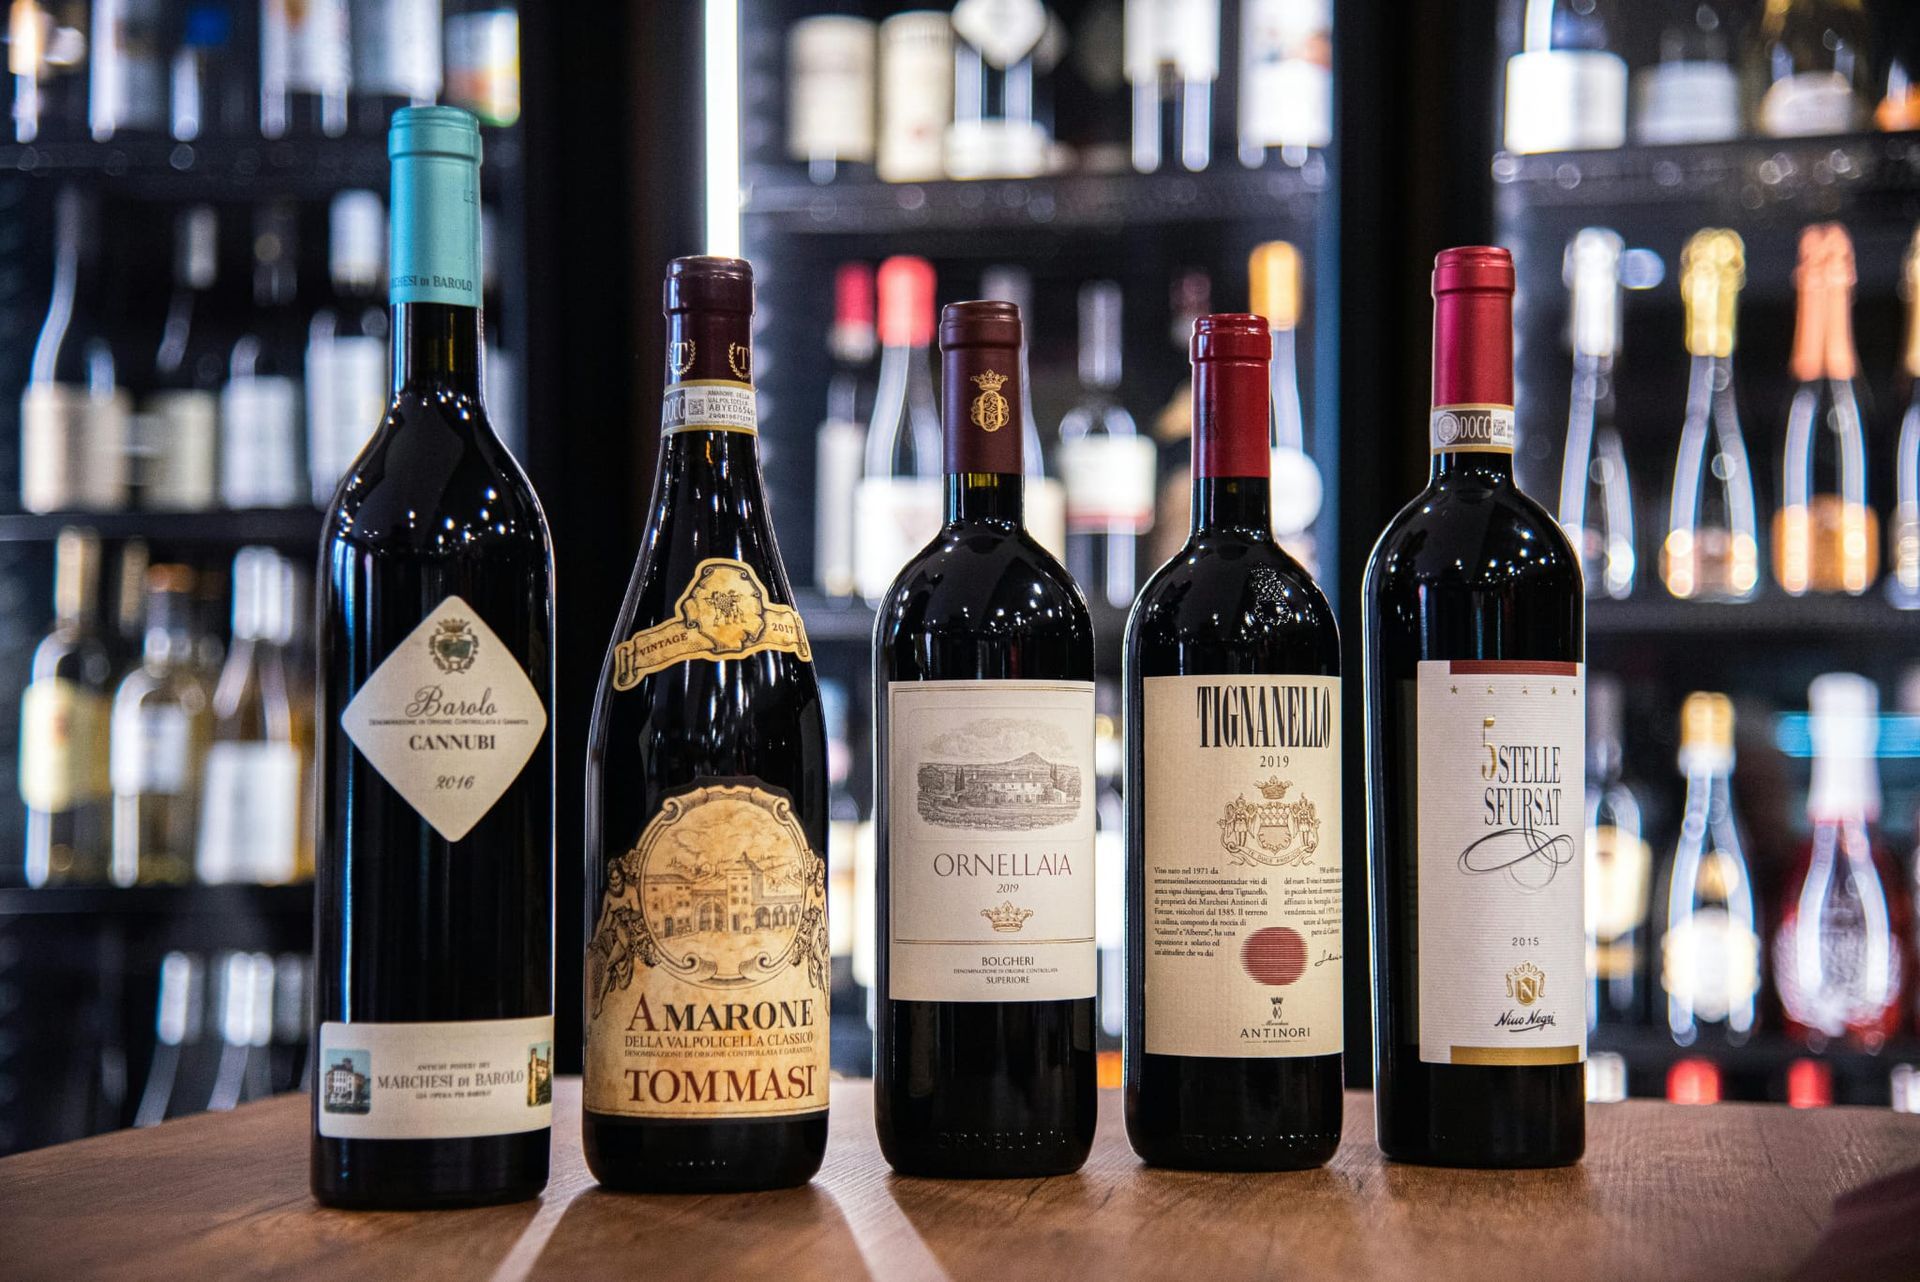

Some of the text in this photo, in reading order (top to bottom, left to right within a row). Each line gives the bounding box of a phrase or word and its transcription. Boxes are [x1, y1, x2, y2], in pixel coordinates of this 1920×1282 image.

[433, 275, 473, 292] BAROLO
[674, 342, 688, 366] T
[736, 346, 749, 370] T
[772, 622, 794, 634] 2017
[640, 632, 688, 656] VINTAGE
[405, 685, 497, 718] Barolo
[1196, 685, 1331, 748] TIGNANELLO
[409, 734, 495, 751] CANNUBI
[1482, 715, 1561, 783] 5 STELLE
[1260, 755, 1289, 768] 2019
[435, 775, 475, 790] 2016
[934, 853, 1072, 877] ORNELLAIA
[996, 883, 1019, 894] 2019
[1512, 937, 1540, 947] 2015
[982, 956, 1034, 966] BOLGHERI
[986, 976, 1031, 984] SUPERIORE
[625, 992, 814, 1032] AMARONE
[625, 1031, 814, 1048] DELLA VALPOLICELLA CLASSICO
[1240, 1027, 1311, 1039] ANTINORI
[377, 1073, 453, 1090] MARCHESI
[475, 1069, 524, 1088] BAROLO
[624, 1065, 817, 1104] TOMMASI
